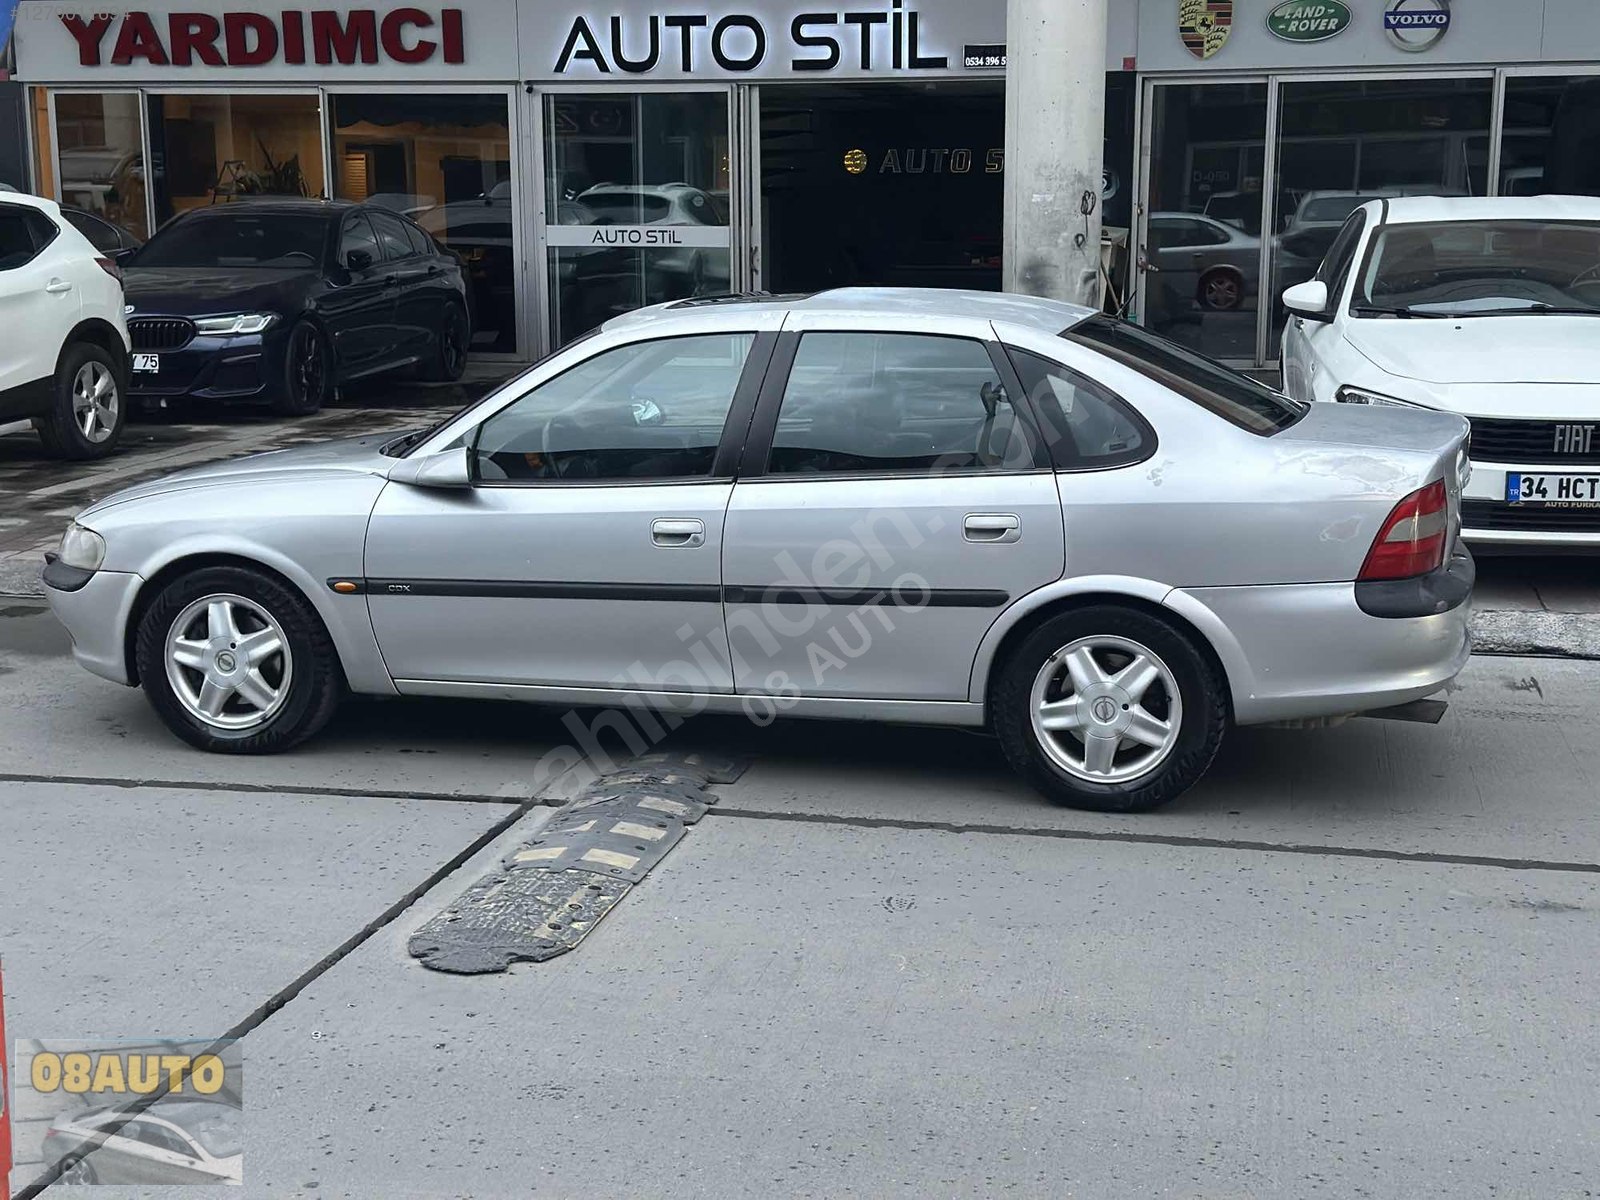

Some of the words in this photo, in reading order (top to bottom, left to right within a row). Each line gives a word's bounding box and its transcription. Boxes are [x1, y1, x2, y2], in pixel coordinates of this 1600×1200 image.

[1287, 18, 1339, 33] ROVER
[1387, 13, 1447, 26] VOLVO
[63, 8, 465, 67] YARDIMCI
[554, 14, 768, 74] AUTO
[965, 56, 984, 66] 0534
[985, 56, 1000, 66] 396
[878, 148, 972, 174] AUTO
[592, 229, 642, 244] AUTO
[142, 355, 158, 368] 75
[1553, 424, 1596, 454] FIAT
[1509, 488, 1519, 496] TR
[1520, 476, 1548, 499] 34
[1557, 477, 1599, 500] HCT
[388, 584, 411, 592] CDX
